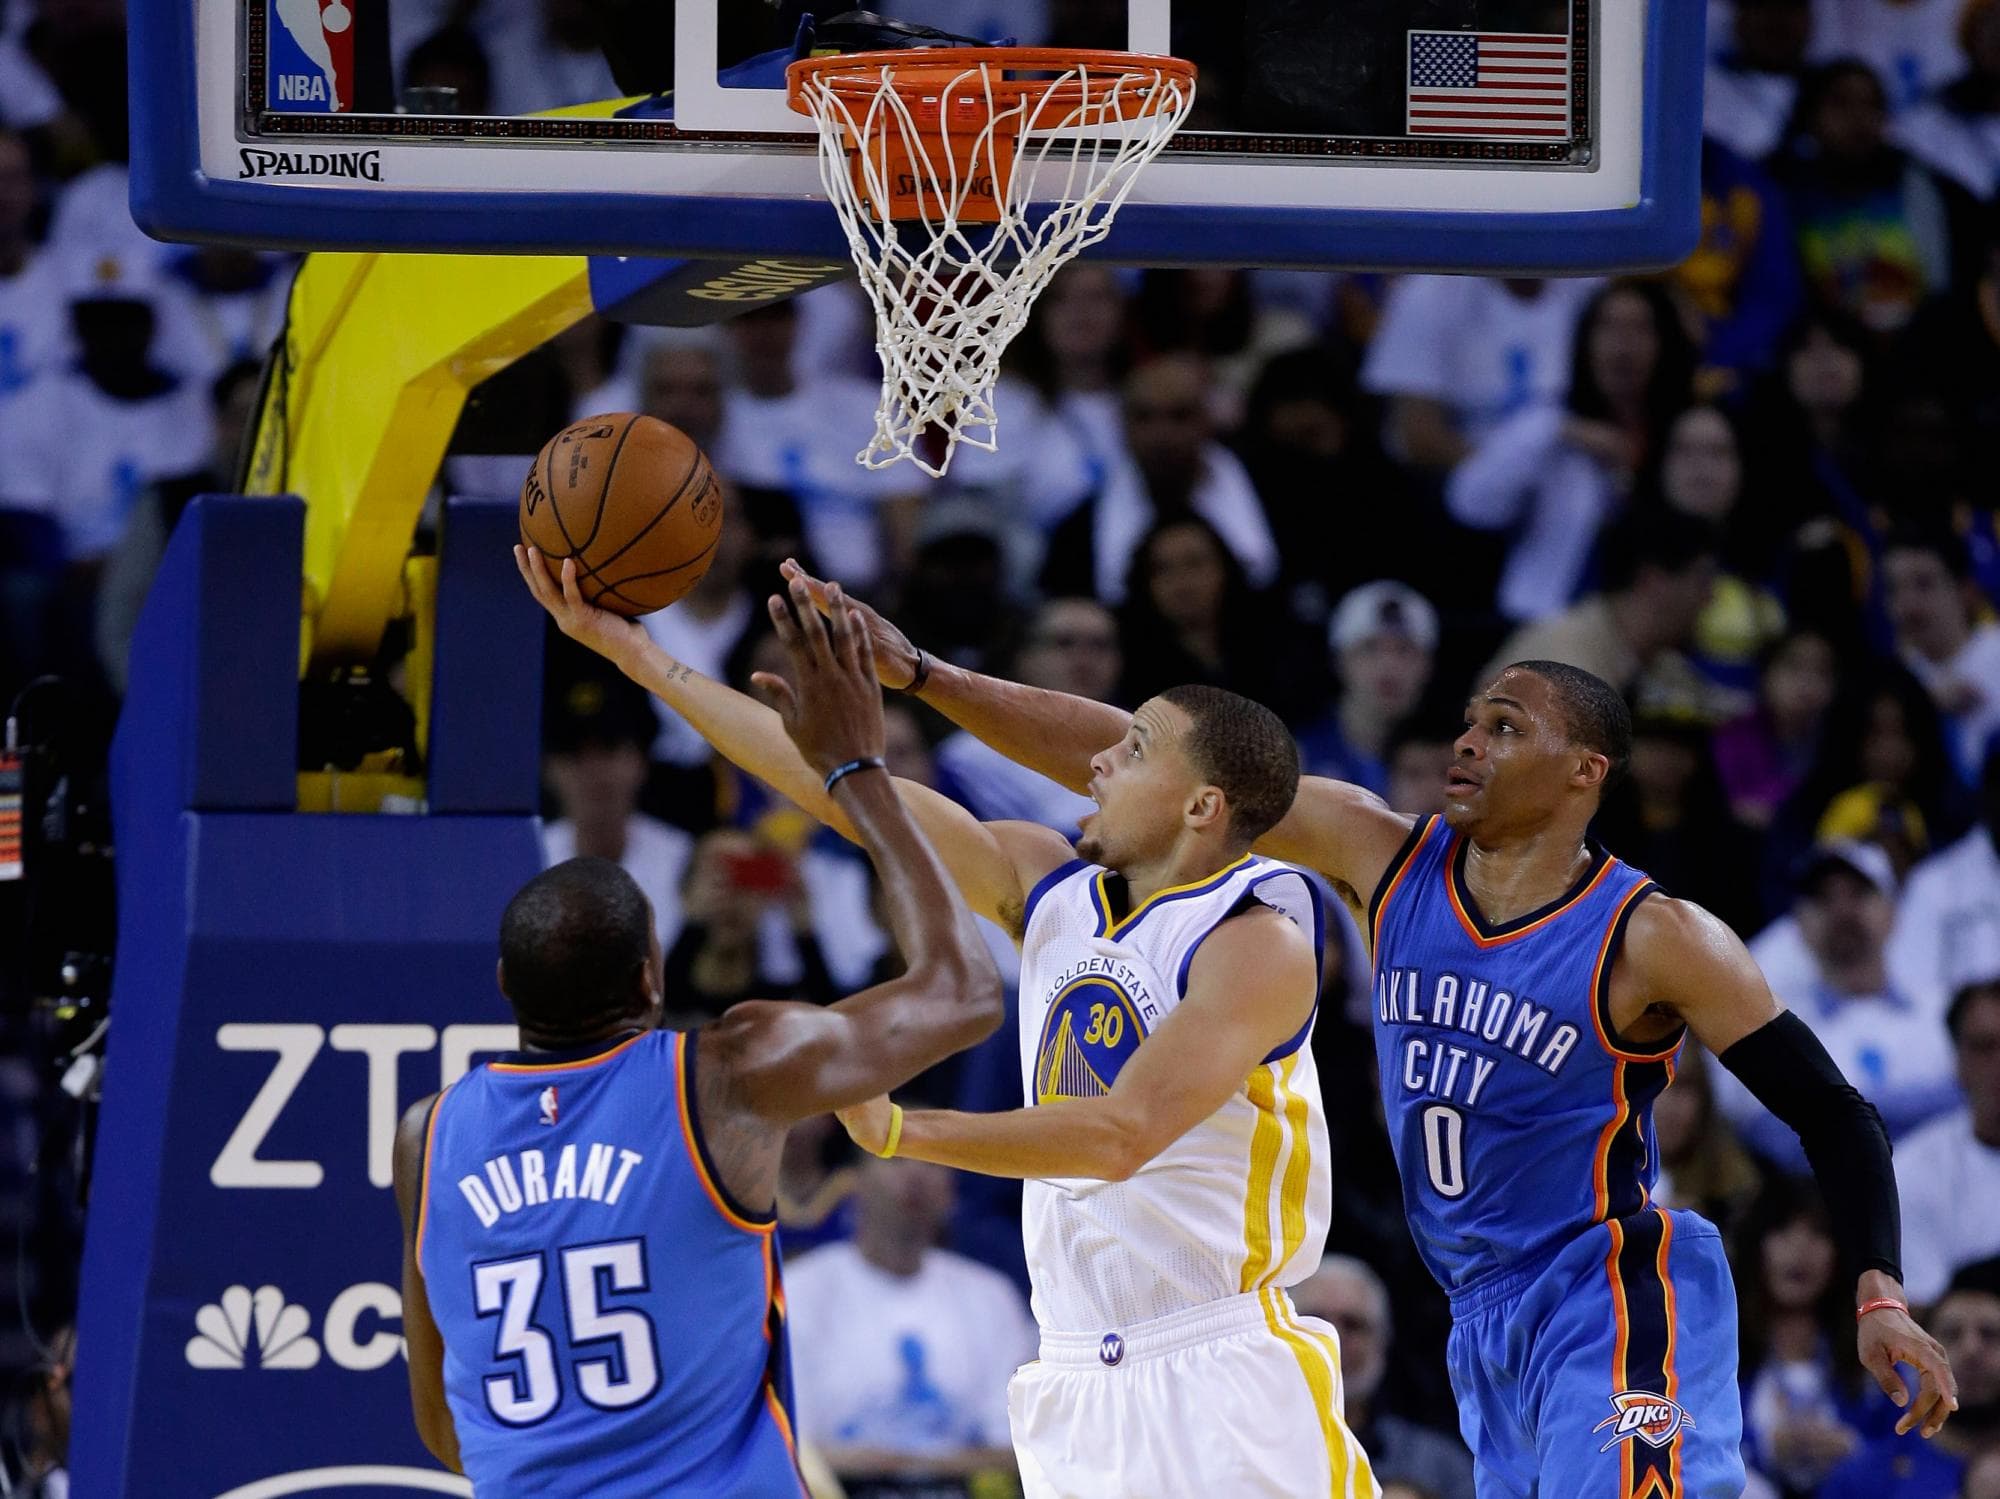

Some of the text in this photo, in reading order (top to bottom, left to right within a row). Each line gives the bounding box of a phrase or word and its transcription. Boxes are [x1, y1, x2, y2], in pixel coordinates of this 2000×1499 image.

[278, 74, 327, 101] NBA
[239, 147, 380, 182] SPALDING
[1045, 957, 1158, 1021] GOLDEN STATE
[1083, 1002, 1124, 1049] 30
[1378, 968, 1581, 1076] OKLAHOMA
[1403, 1038, 1498, 1107] CITY
[1422, 1103, 1466, 1199] 0
[457, 1142, 643, 1229] DURANT
[471, 1235, 663, 1428] 35
[1101, 1340, 1121, 1360] W
[1616, 1404, 1670, 1433] OKC
